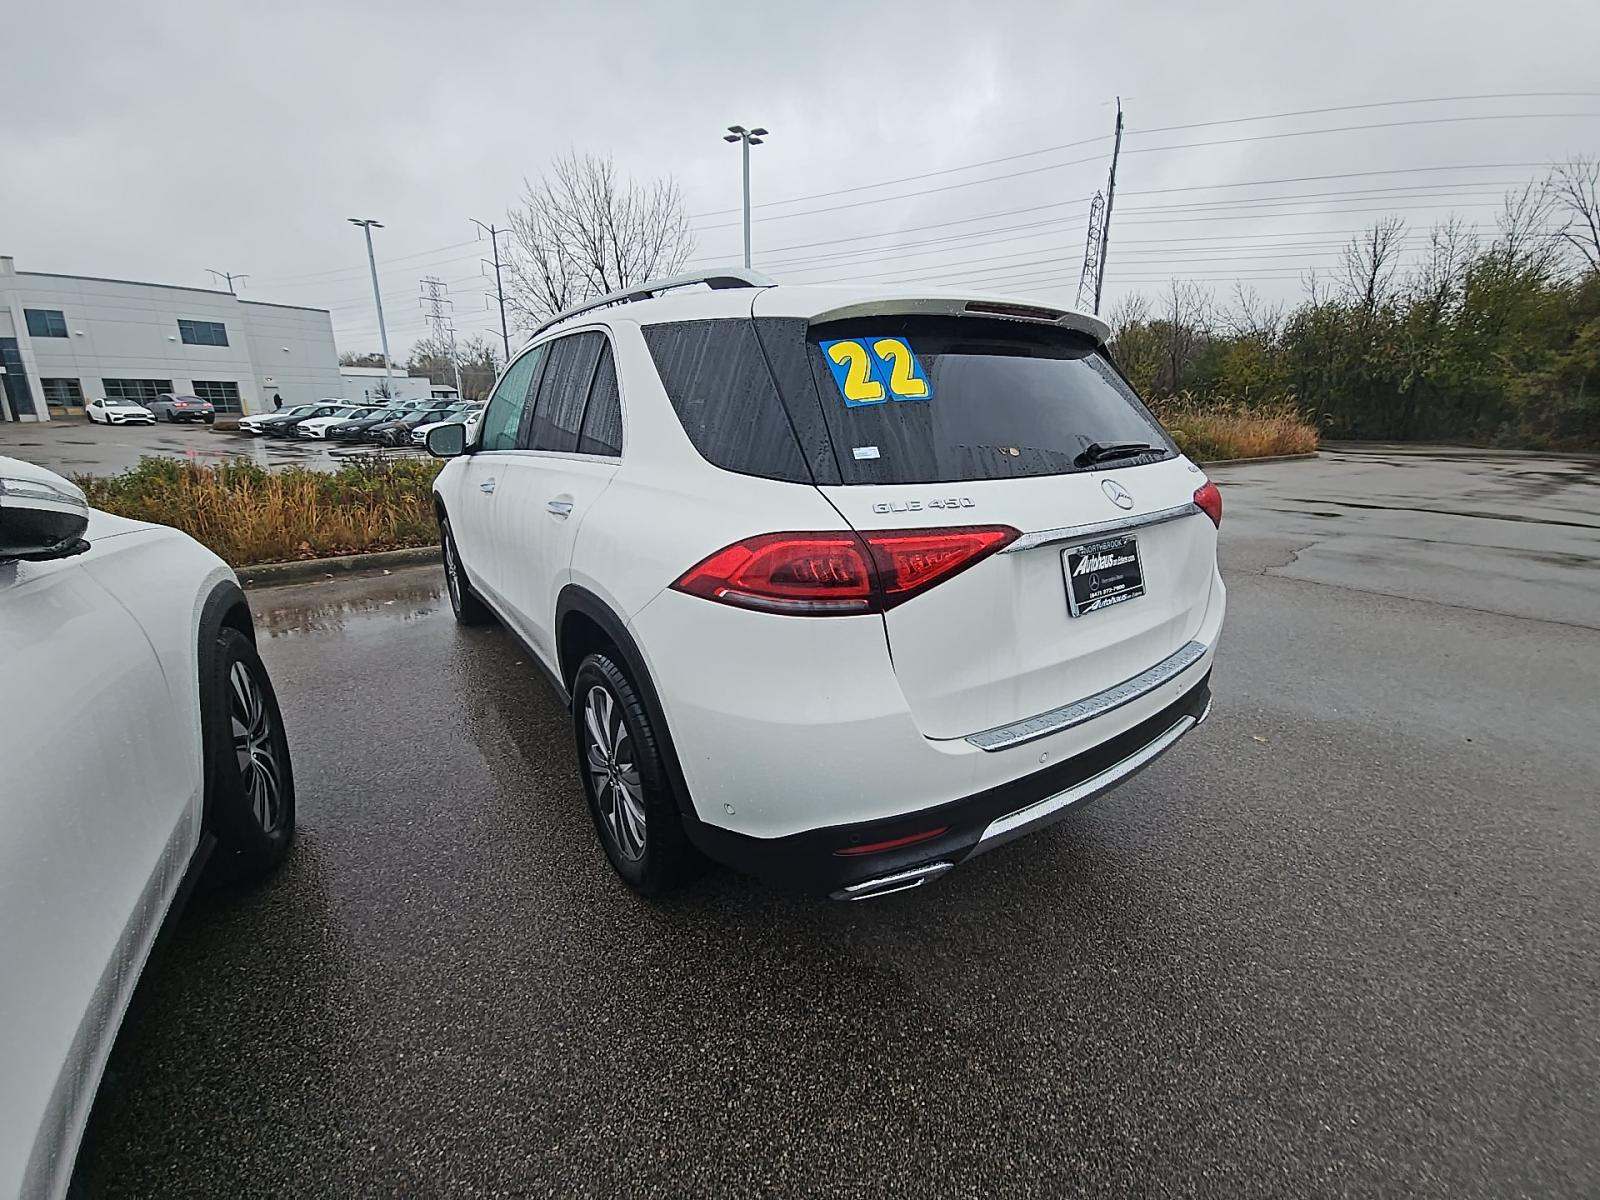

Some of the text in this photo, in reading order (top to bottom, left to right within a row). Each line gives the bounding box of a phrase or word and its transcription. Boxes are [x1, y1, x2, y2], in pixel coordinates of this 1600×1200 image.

[828, 339, 929, 402] 22
[872, 497, 976, 514] GLE 450
[1072, 552, 1114, 577] Autohaus
